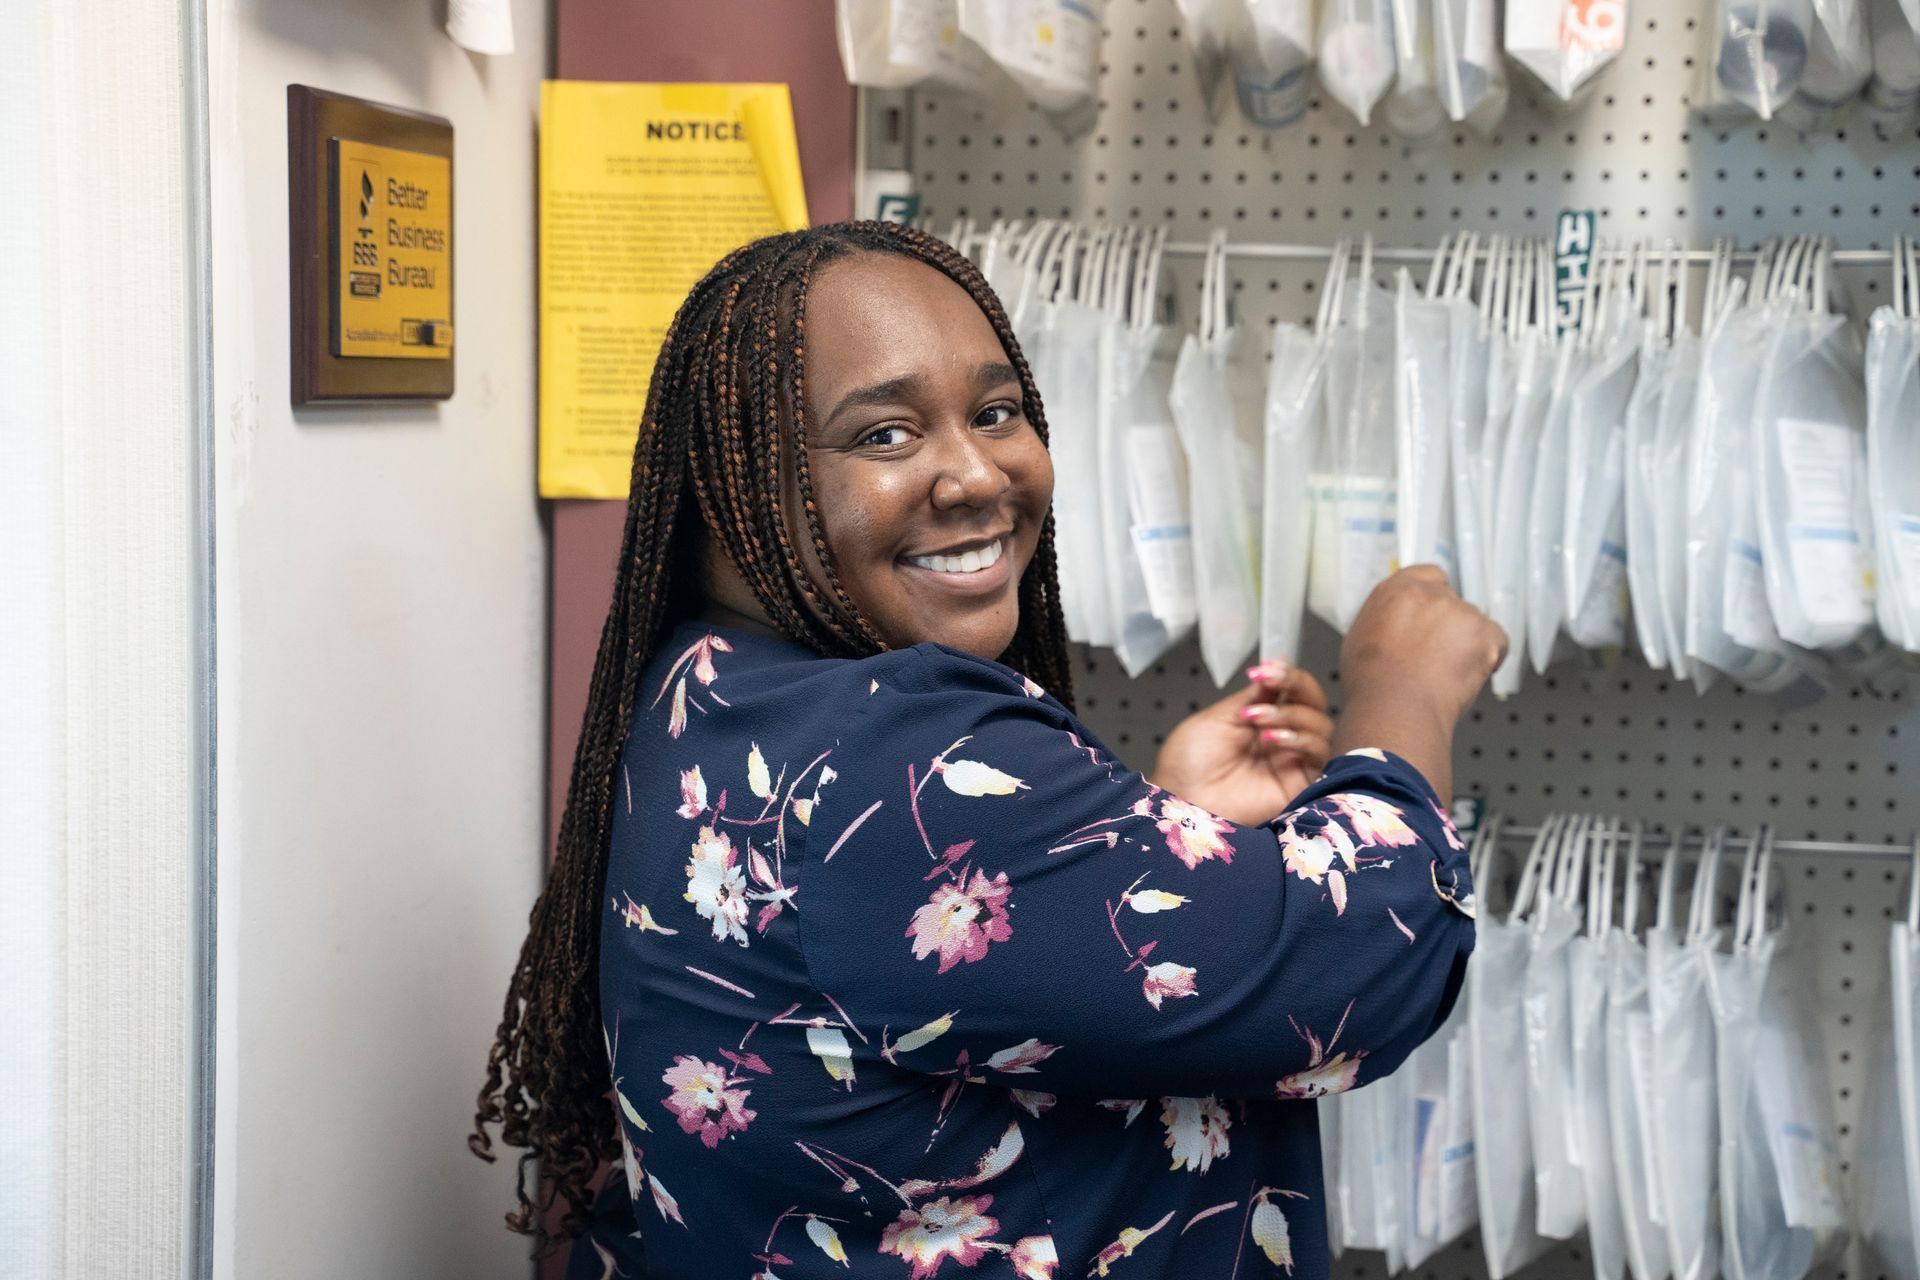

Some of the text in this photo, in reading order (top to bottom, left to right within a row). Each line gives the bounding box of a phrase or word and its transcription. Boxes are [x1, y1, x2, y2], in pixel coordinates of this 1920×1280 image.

[647, 121, 745, 141] NOTICE
[387, 178, 428, 210] Better
[387, 217, 445, 252] Business
[353, 242, 378, 266] BBB
[387, 257, 435, 289] Bureau
